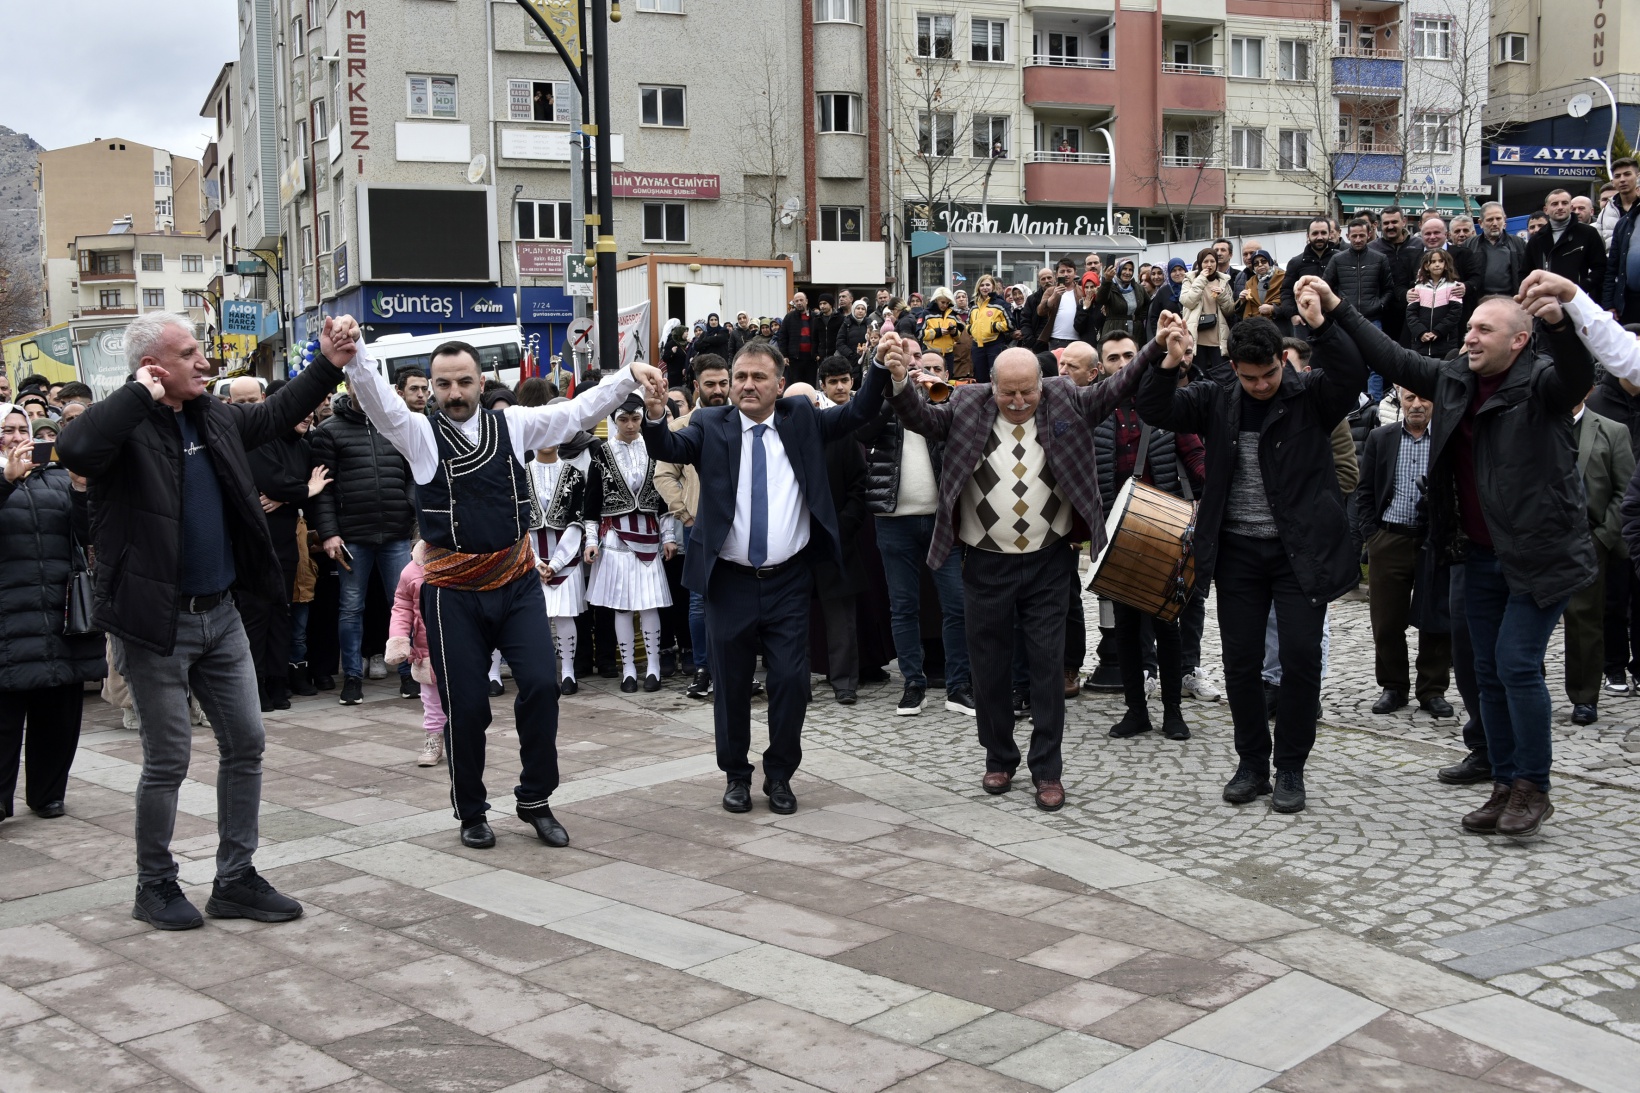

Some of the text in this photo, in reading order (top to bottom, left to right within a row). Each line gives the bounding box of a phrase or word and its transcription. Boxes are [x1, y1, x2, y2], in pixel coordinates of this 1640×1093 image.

[346, 10, 370, 174] MERKEZİ
[1534, 167, 1550, 176] KIZ
[633, 176, 670, 187] YAYMA
[671, 176, 718, 188] CEMİYETİ
[1343, 183, 1390, 191] MERKEZ
[380, 293, 453, 318] güntaş
[229, 312, 256, 320] HARCA
[229, 318, 256, 326] HARCA
